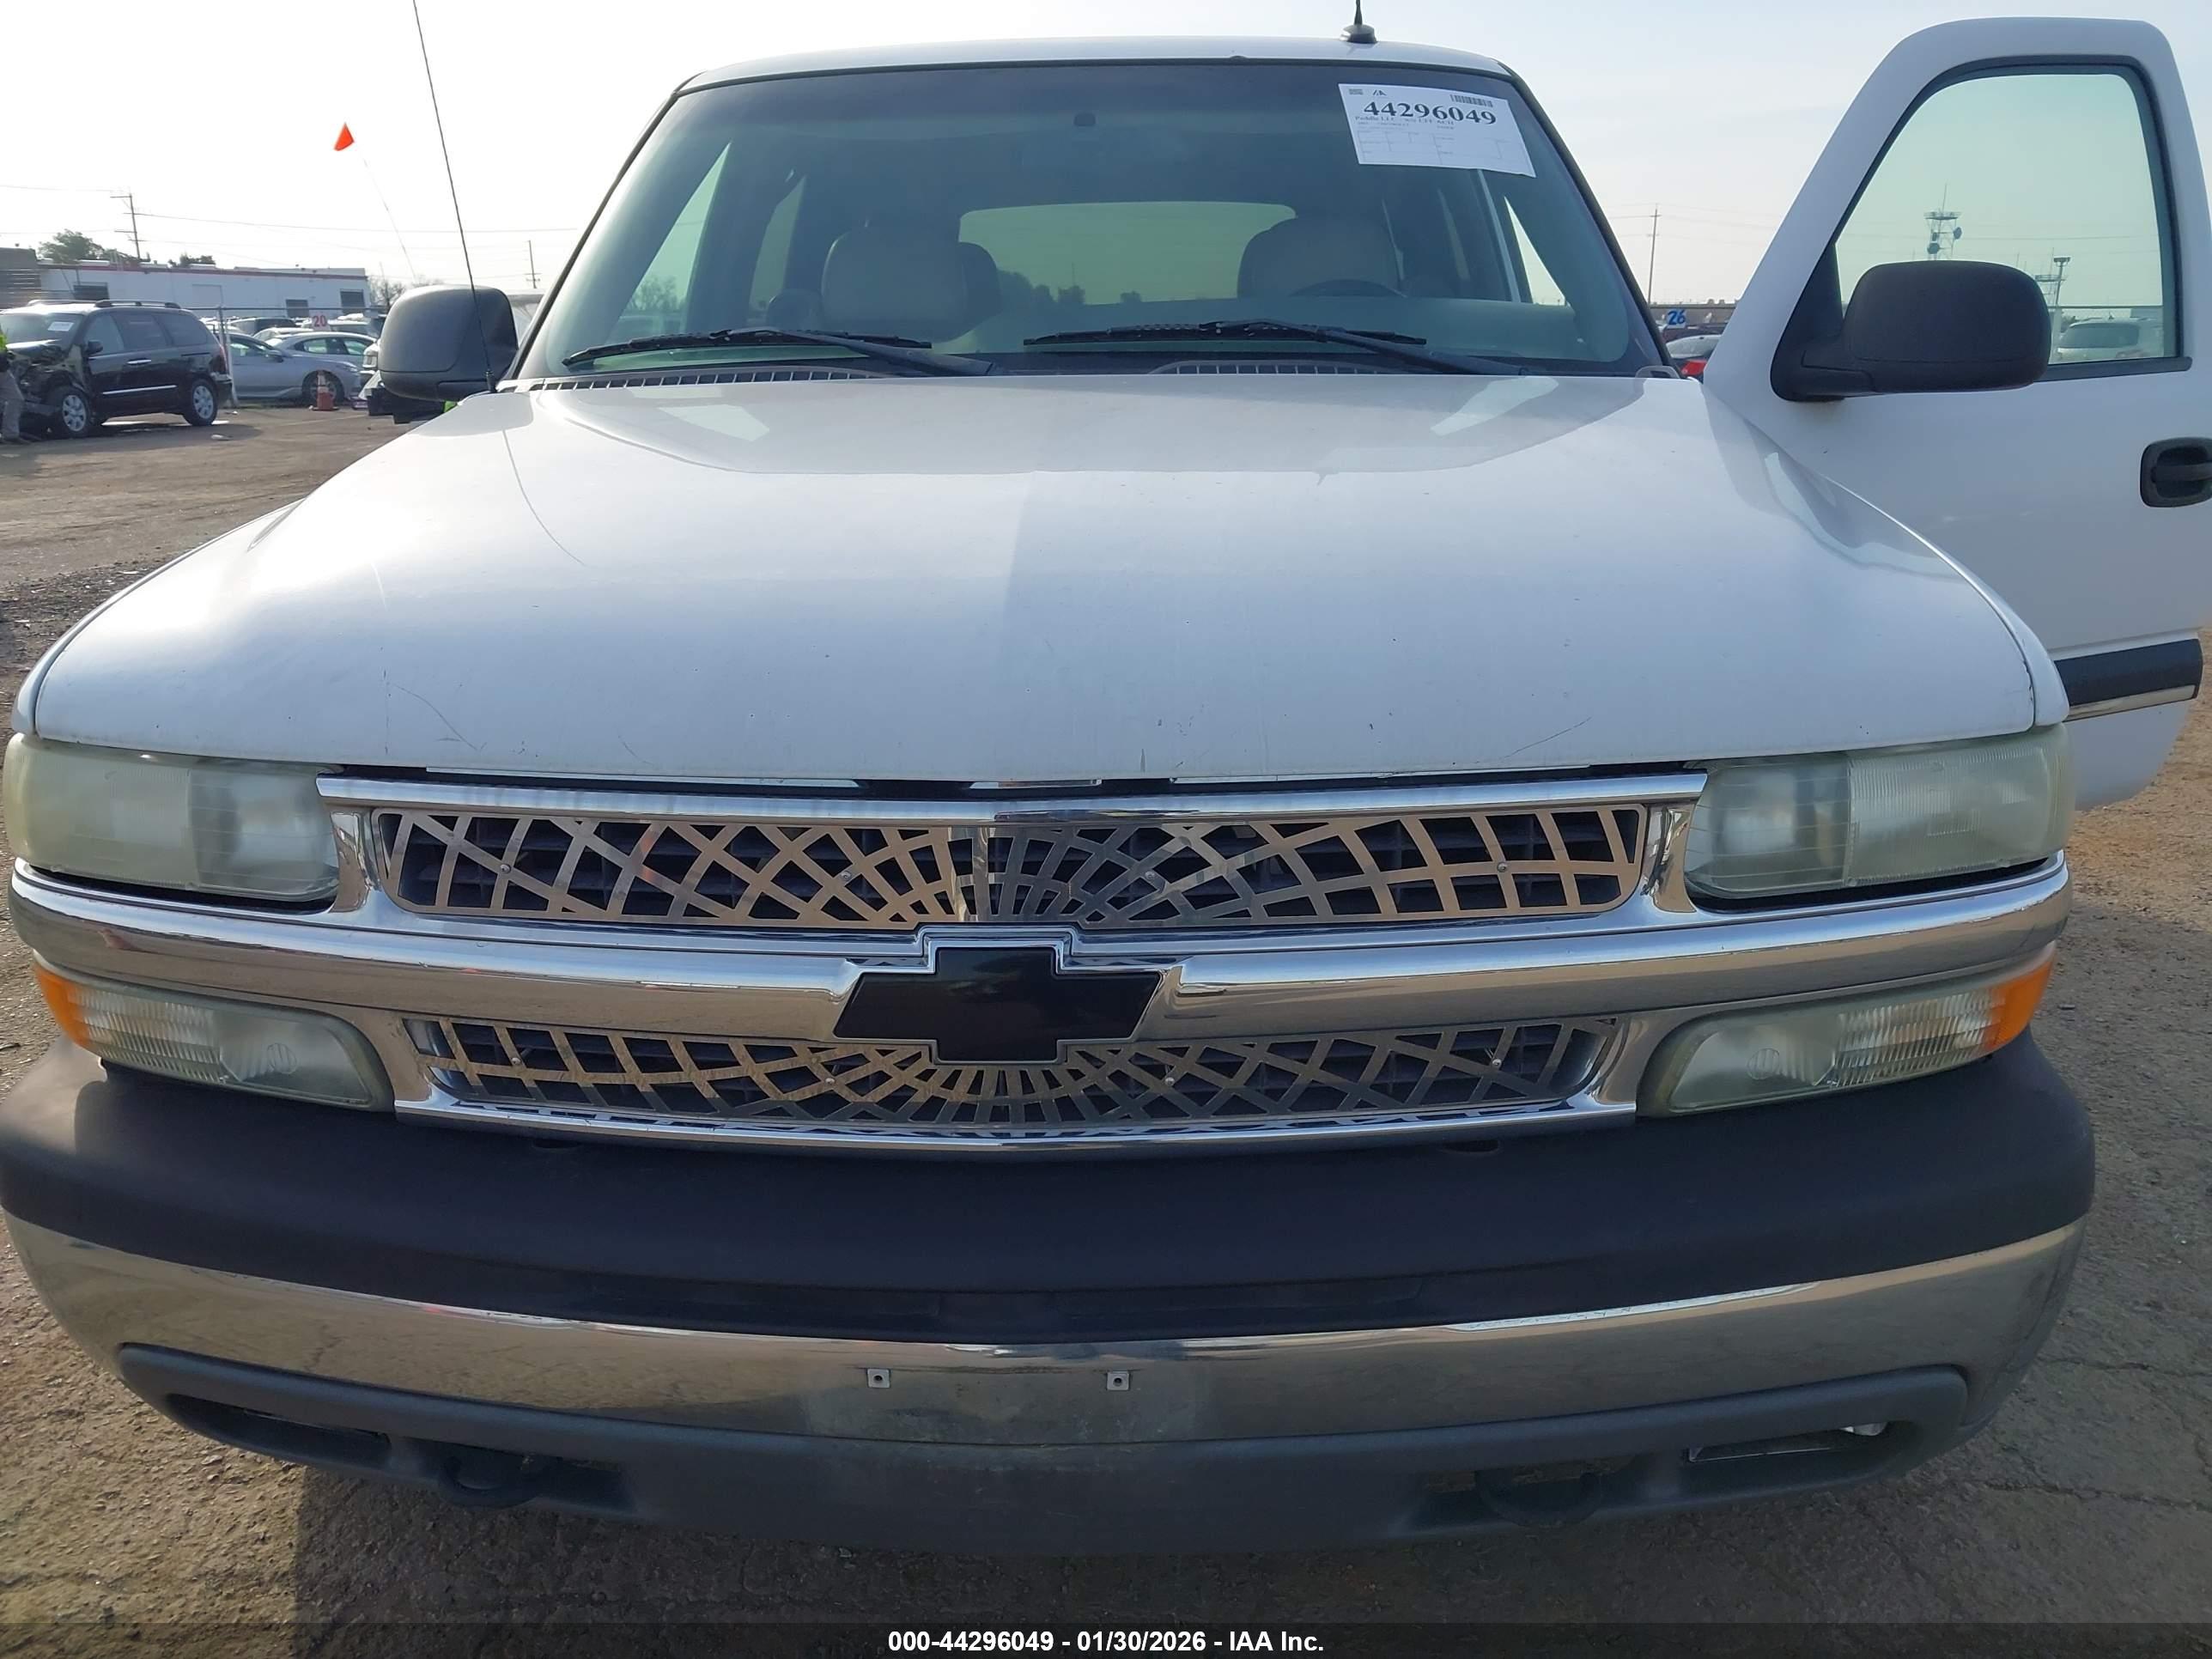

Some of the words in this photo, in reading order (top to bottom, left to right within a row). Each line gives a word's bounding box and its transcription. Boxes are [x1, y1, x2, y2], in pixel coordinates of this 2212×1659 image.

[1364, 101, 1497, 125] 44296049
[313, 314, 328, 327] 20
[1668, 309, 1686, 325] 26
